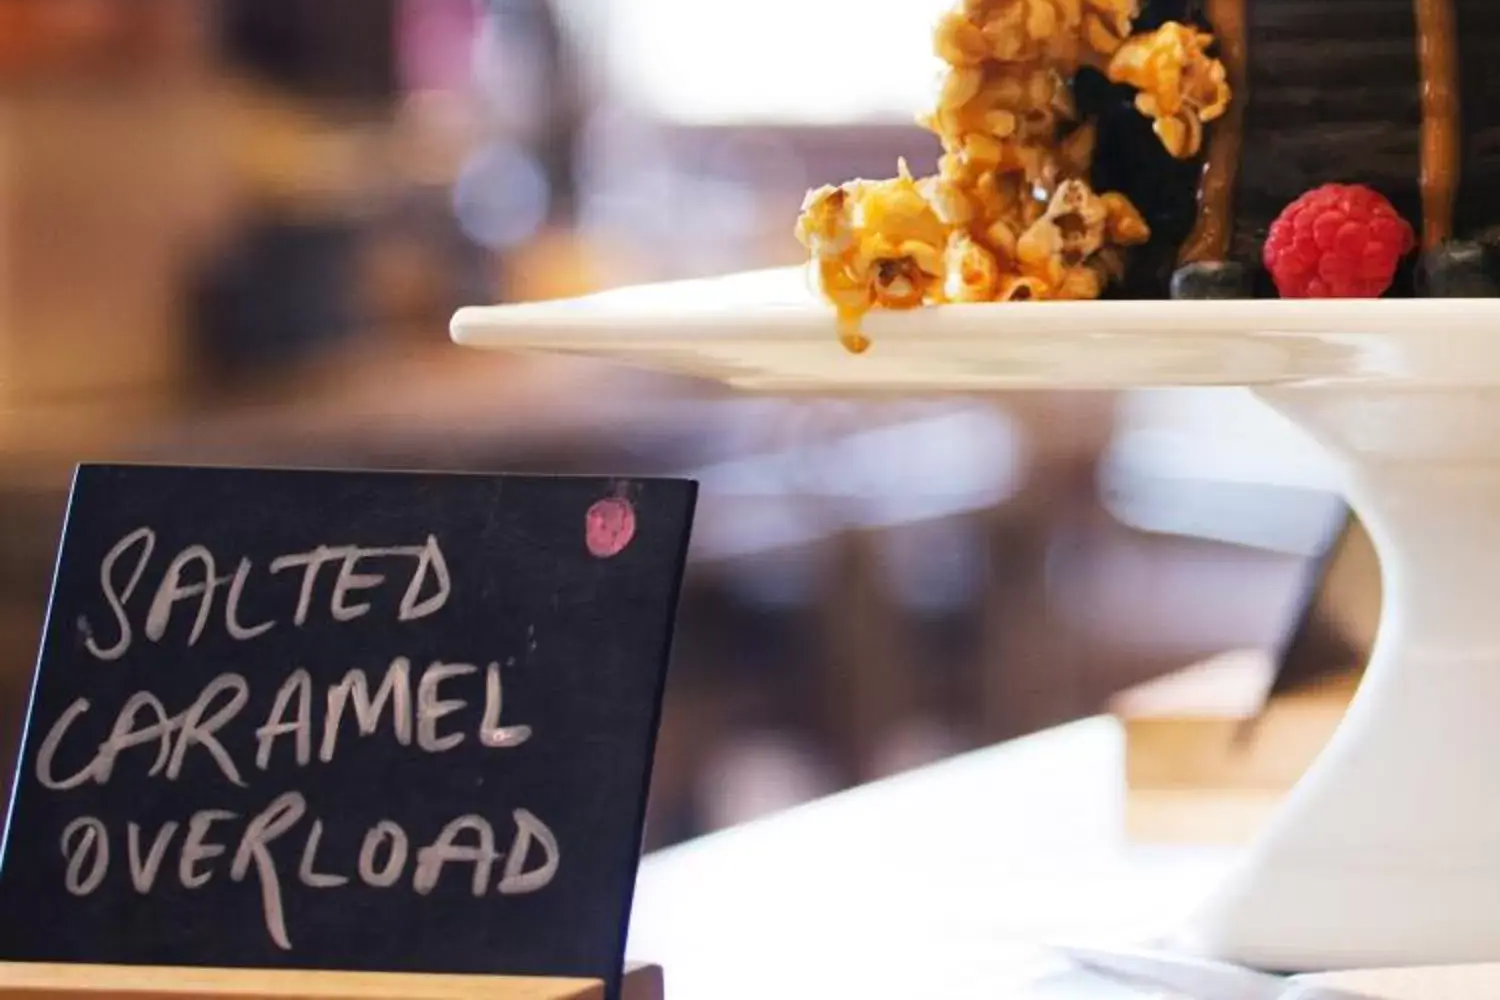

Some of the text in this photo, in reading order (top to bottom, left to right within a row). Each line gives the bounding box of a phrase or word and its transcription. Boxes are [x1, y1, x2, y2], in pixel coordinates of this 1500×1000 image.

[78, 526, 451, 661] SALTED
[36, 656, 532, 791] CARAMEL
[61, 791, 560, 950] OVERLOAD
